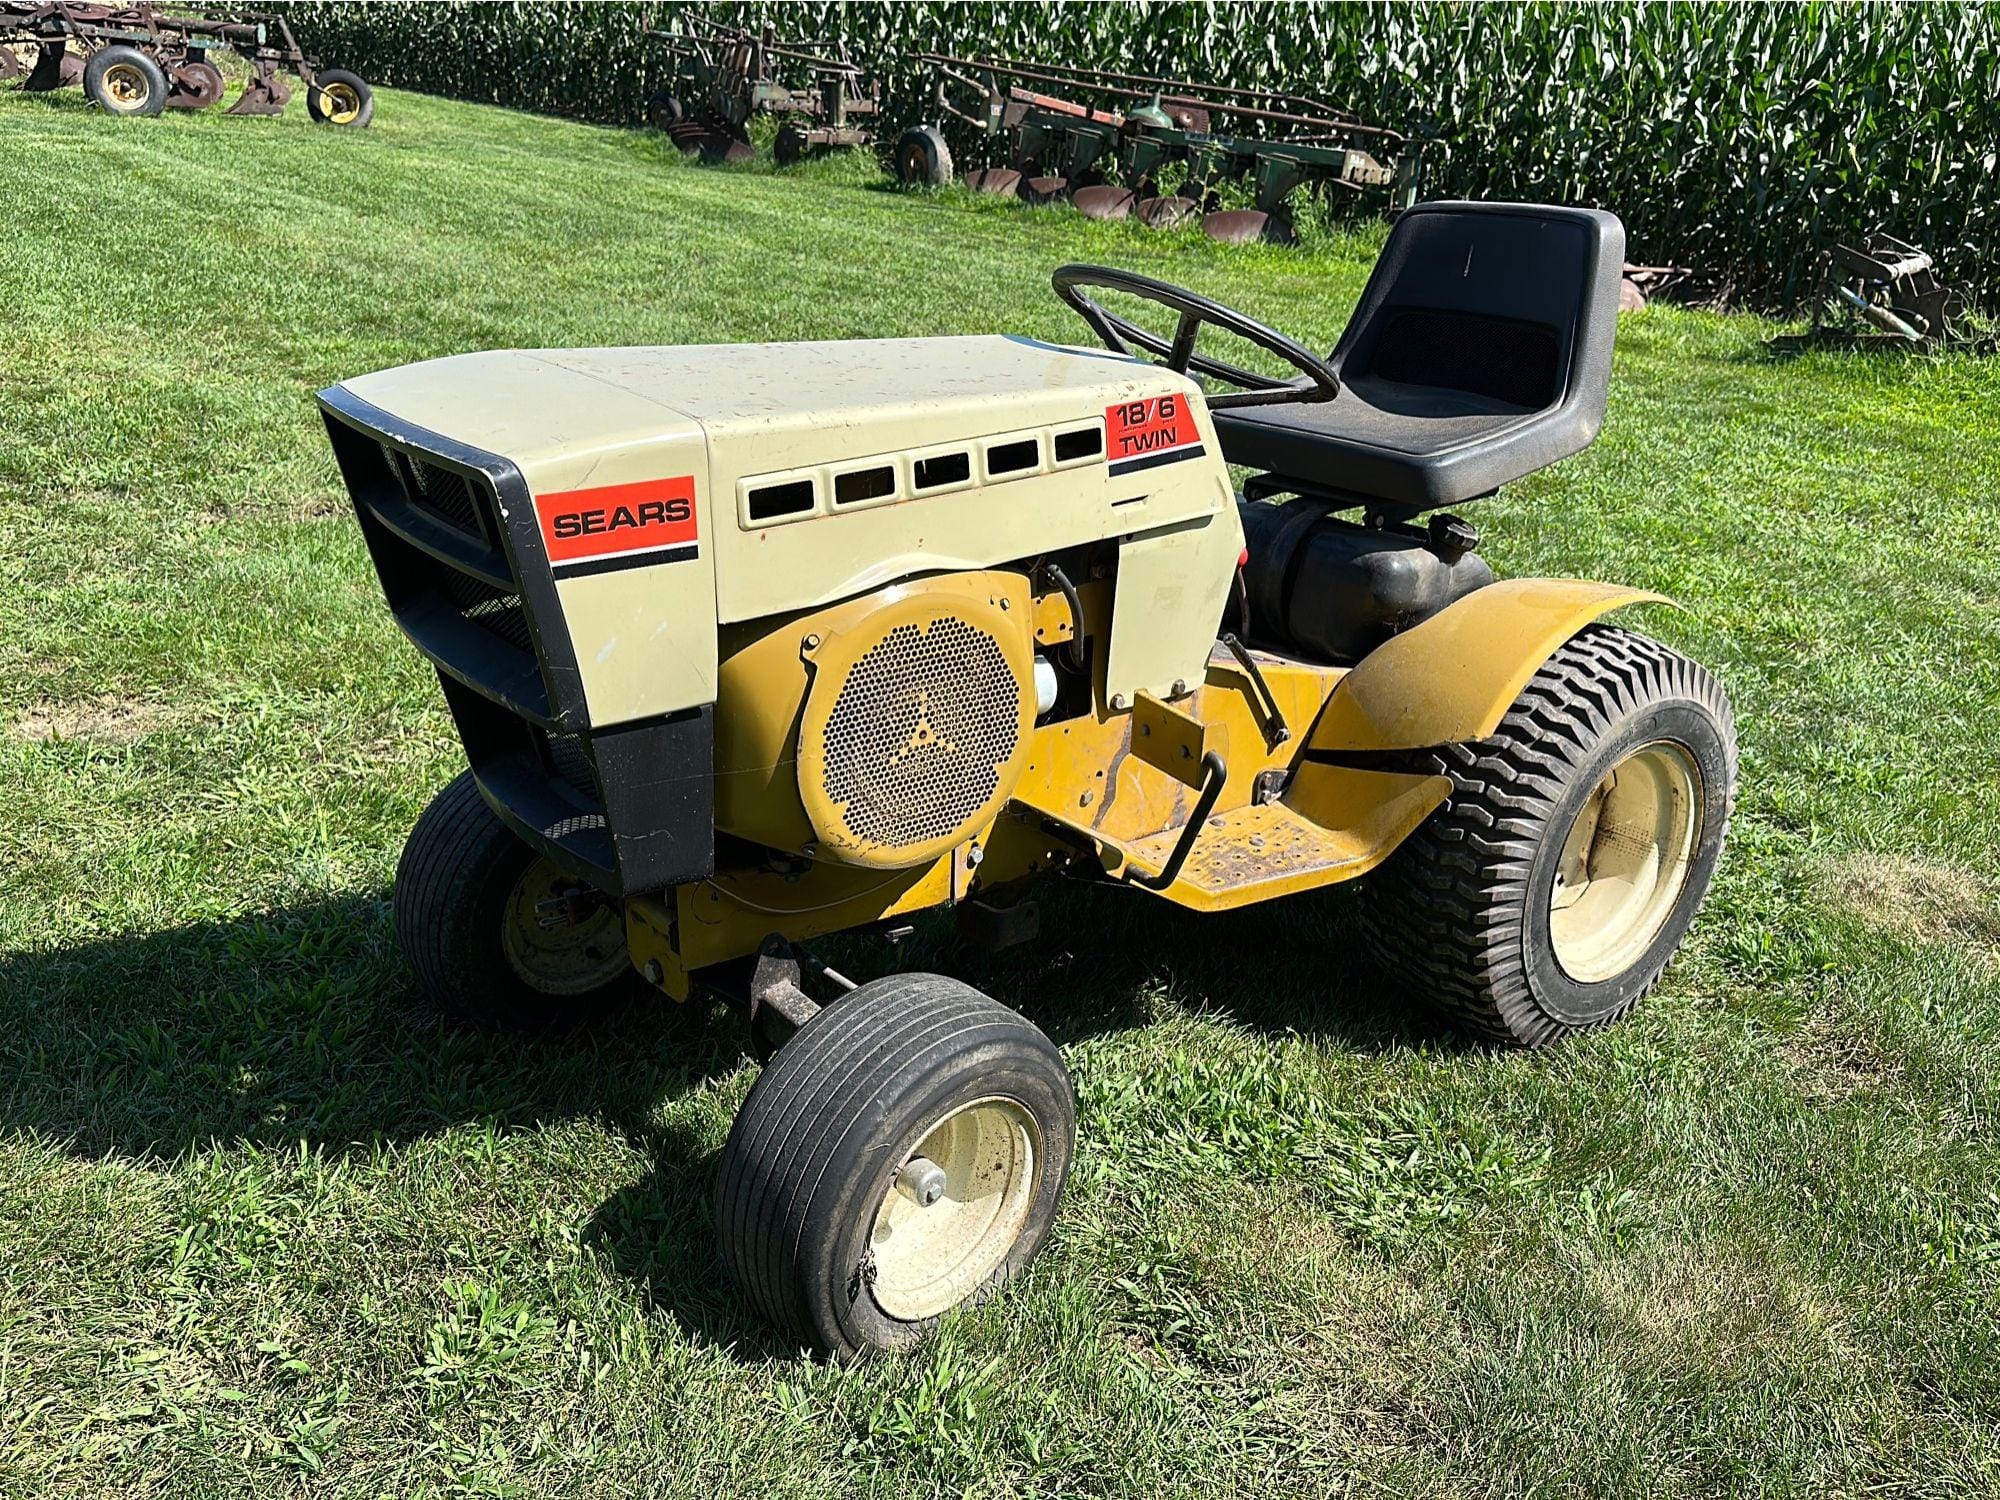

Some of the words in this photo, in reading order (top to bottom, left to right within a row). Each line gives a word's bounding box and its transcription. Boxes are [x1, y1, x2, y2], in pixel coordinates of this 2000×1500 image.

[1116, 396, 1176, 428] 18/6
[1119, 426, 1177, 454] TWIN
[553, 498, 691, 539] SEARS
